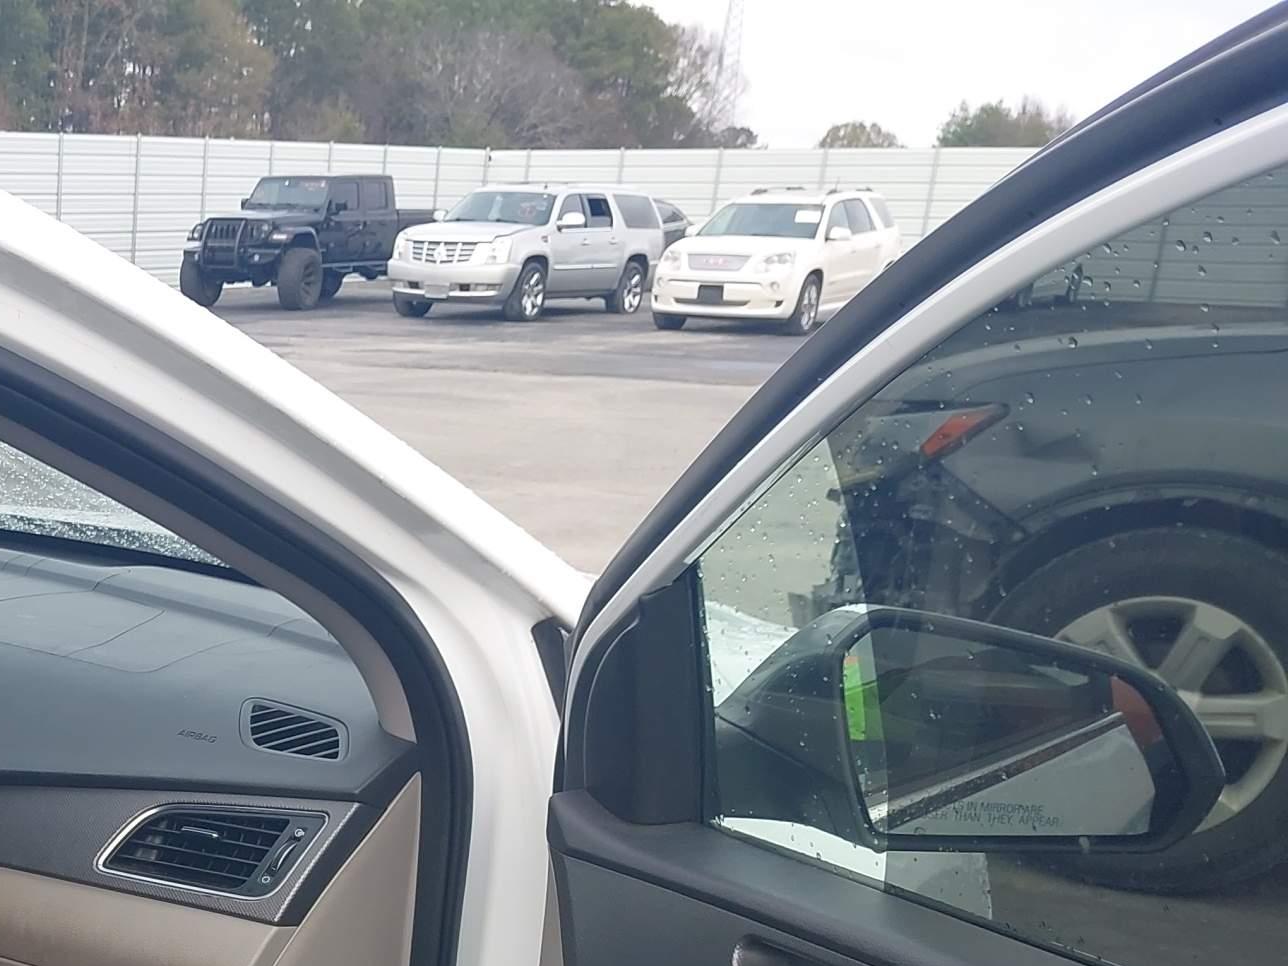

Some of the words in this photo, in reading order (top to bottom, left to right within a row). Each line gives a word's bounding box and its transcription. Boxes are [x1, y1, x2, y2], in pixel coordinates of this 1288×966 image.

[176, 729, 217, 744] AIRBAG
[981, 801, 1021, 815] MIRROR
[954, 811, 981, 822] THAN
[987, 811, 1013, 825] THEY
[1018, 814, 1060, 827] APPEAR
